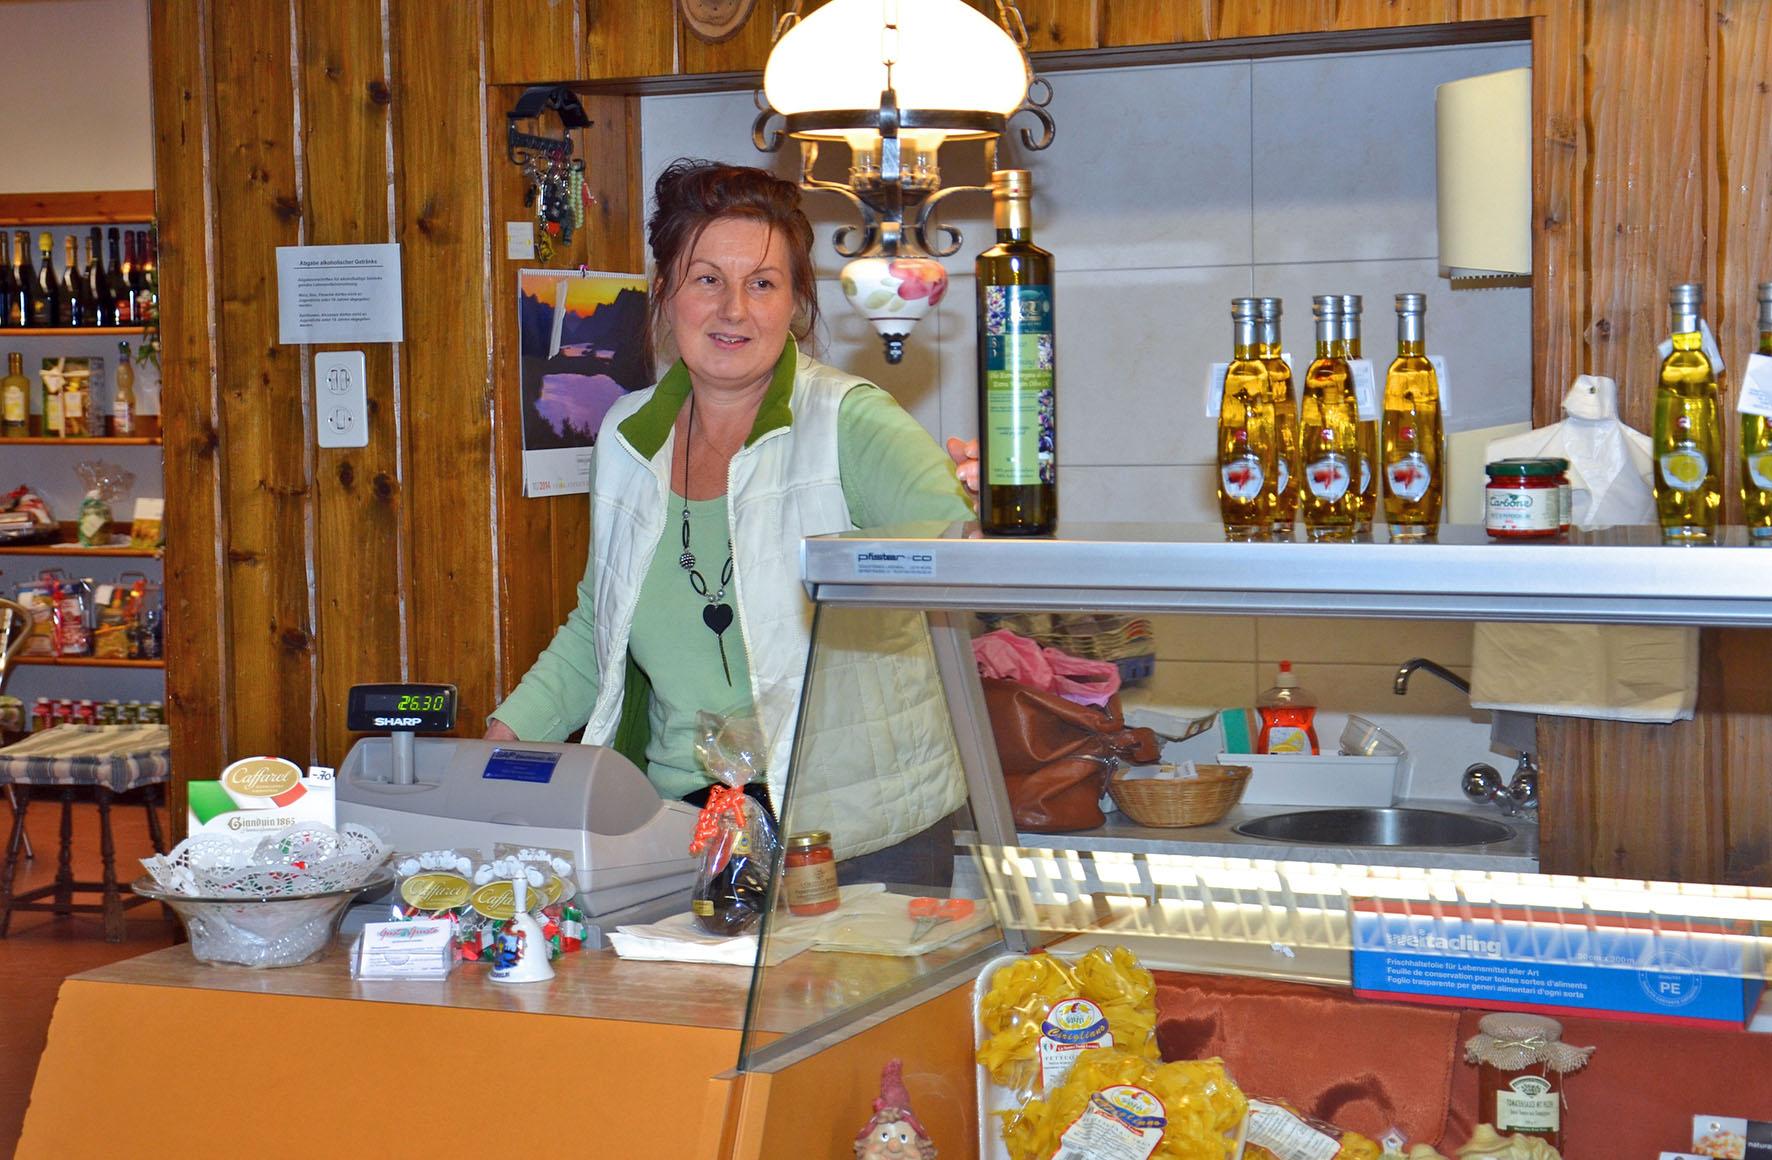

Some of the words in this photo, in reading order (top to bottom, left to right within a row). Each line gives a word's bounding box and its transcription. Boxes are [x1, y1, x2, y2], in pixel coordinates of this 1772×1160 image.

[398, 695, 444, 711] 26.30
[374, 717, 422, 726] SHARP
[232, 767, 290, 790] Caffarel
[277, 817, 295, 826] 1865
[409, 877, 464, 904] Caffarel
[1386, 928, 1502, 959] weitacling
[1387, 958, 1444, 970] Frischhaltefolie
[1445, 961, 1457, 970] für
[1458, 963, 1507, 974] Lebensmittel
[1509, 967, 1525, 975] aller
[1527, 968, 1539, 977] Art
[1387, 967, 1411, 976] Feuille
[1413, 968, 1423, 976] de
[1424, 970, 1473, 980] conservation
[1475, 974, 1493, 983] pour
[1495, 974, 1519, 984] toutes
[1521, 977, 1545, 986] sortes
[1547, 978, 1587, 990] d'aliments
[1388, 976, 1410, 986] Foglio
[1412, 977, 1455, 989] trasparente
[1457, 982, 1470, 990] per
[1472, 982, 1495, 992] generi
[1497, 984, 1535, 995] alimentari
[1537, 986, 1561, 998] d'ogni
[1563, 990, 1584, 998] sorta
[1659, 983, 1681, 995] PE
[1047, 1026, 1105, 1041] Cirigliano
